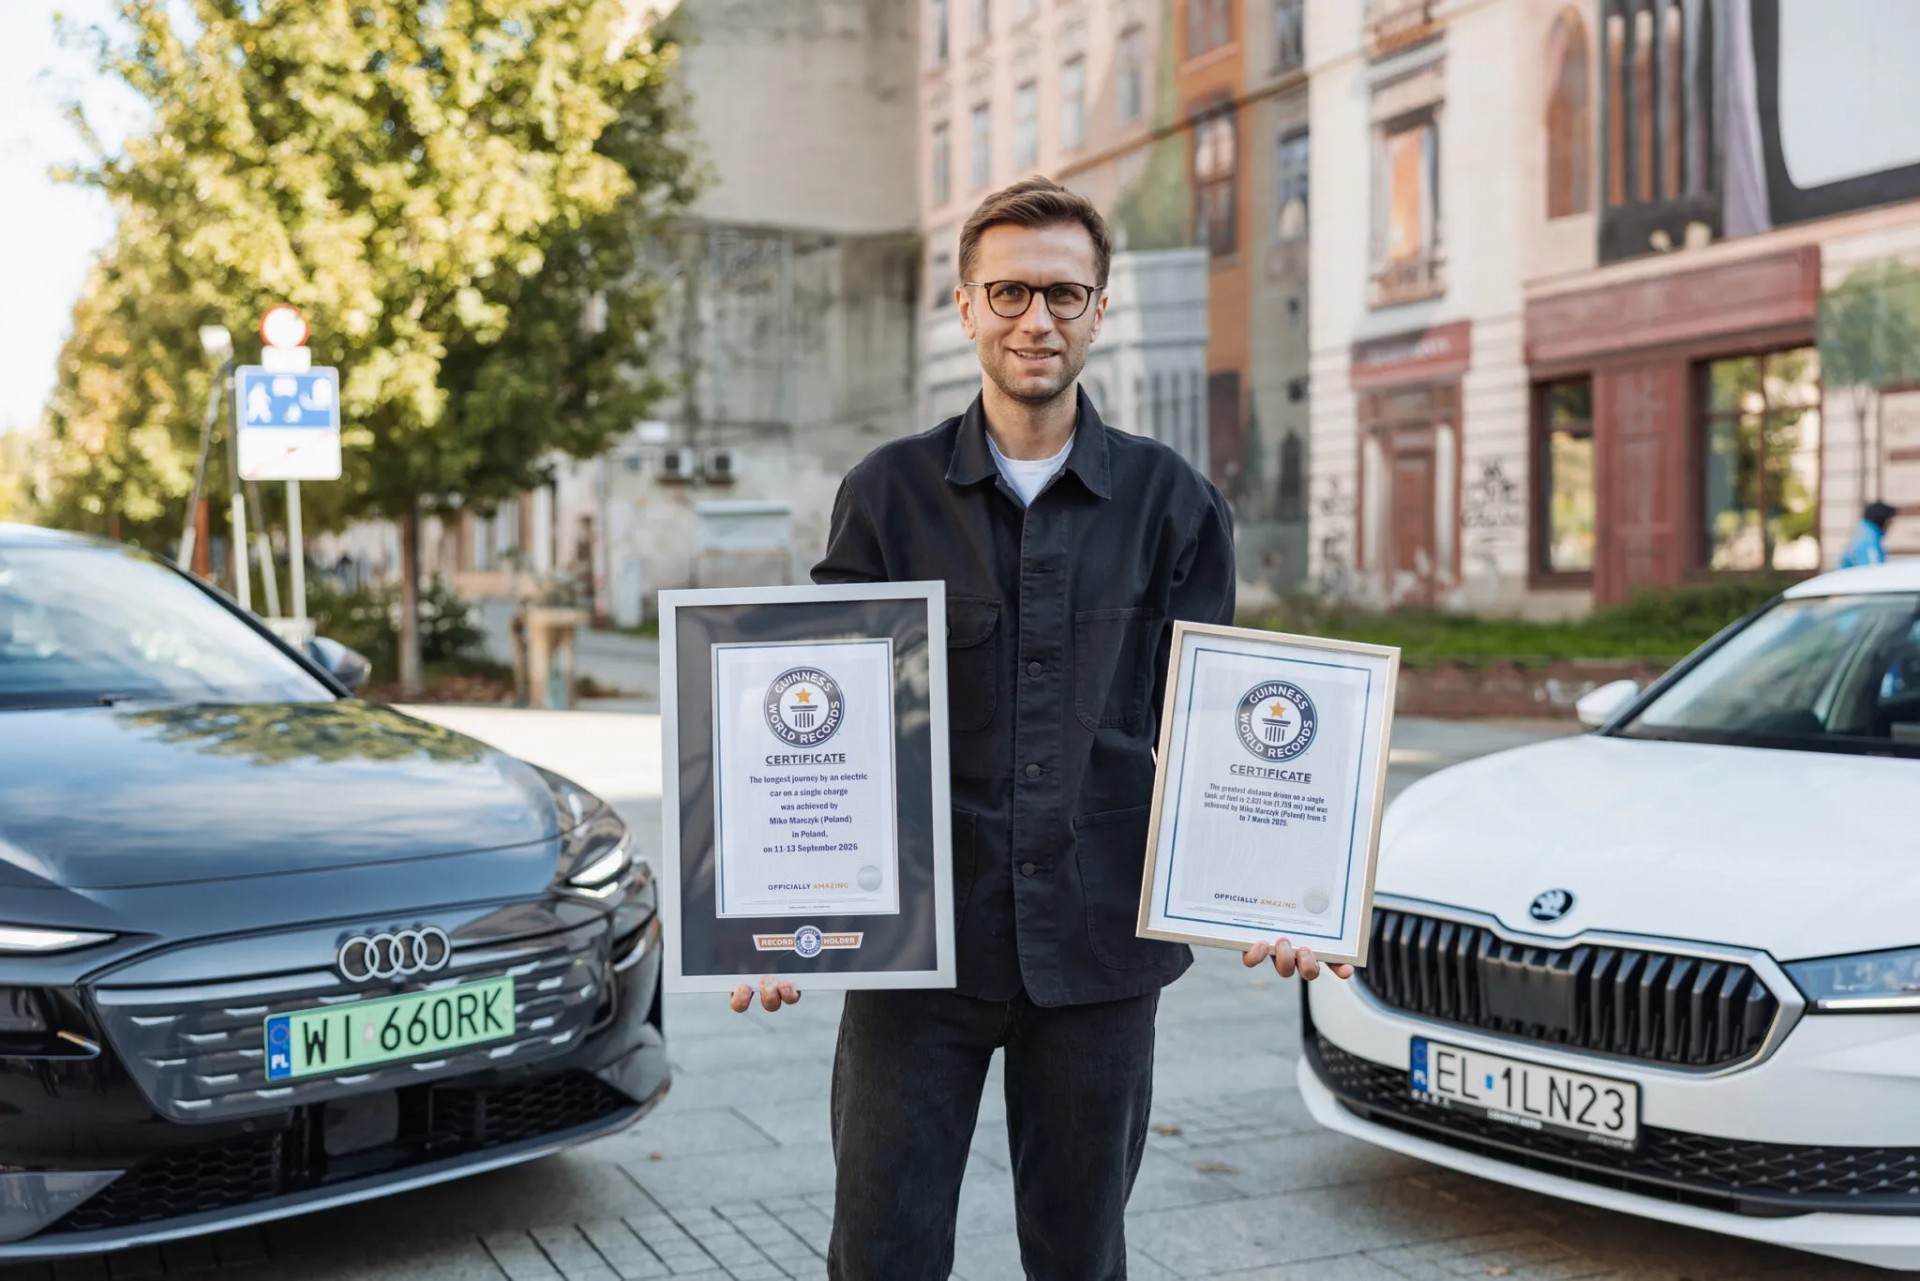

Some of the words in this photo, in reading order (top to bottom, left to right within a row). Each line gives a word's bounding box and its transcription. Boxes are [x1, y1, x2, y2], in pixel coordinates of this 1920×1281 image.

[774, 671, 833, 694] GUINNESS
[1249, 685, 1309, 710] GUINNESS
[768, 703, 796, 741] WORLD
[800, 700, 840, 744] RECORDS
[1240, 712, 1264, 753] WORLD
[1267, 720, 1313, 758] RECORDS
[765, 753, 846, 765] CERTIFICATE
[750, 776, 762, 784] The
[764, 776, 791, 784] longest
[791, 775, 818, 784] journey
[820, 774, 828, 783] by
[1229, 764, 1312, 783] CERTIFICATE
[800, 789, 821, 797] single
[824, 788, 848, 797] charge
[1204, 792, 1218, 800] tank
[1226, 794, 1238, 802] fuel
[1293, 803, 1303, 811] mi)
[1221, 785, 1246, 794] greatest
[1247, 787, 1272, 797] distance
[1273, 791, 1292, 800] driven
[1307, 795, 1325, 805] single
[796, 802, 828, 810] achieved
[830, 802, 838, 810] by
[1204, 800, 1230, 810] achieved
[1231, 803, 1238, 812] by
[1239, 805, 1253, 813] Miko
[1255, 807, 1279, 817] Marczyk
[1280, 809, 1305, 820] (Poland)
[1306, 814, 1320, 822] from
[789, 817, 819, 825] Marczyk
[821, 815, 852, 824] (Poland)
[1252, 816, 1270, 824] March
[798, 844, 837, 853] September
[1214, 893, 1258, 904] OFFICIALLY
[1260, 900, 1296, 909] AMAZING
[761, 938, 794, 946] RECORD
[823, 937, 855, 945] HOLDER
[303, 1014, 351, 1067] WI
[380, 987, 503, 1051] 660RK
[271, 1053, 289, 1070] PL
[1437, 1051, 1479, 1100] EL
[1502, 1067, 1625, 1131] 1LN23
